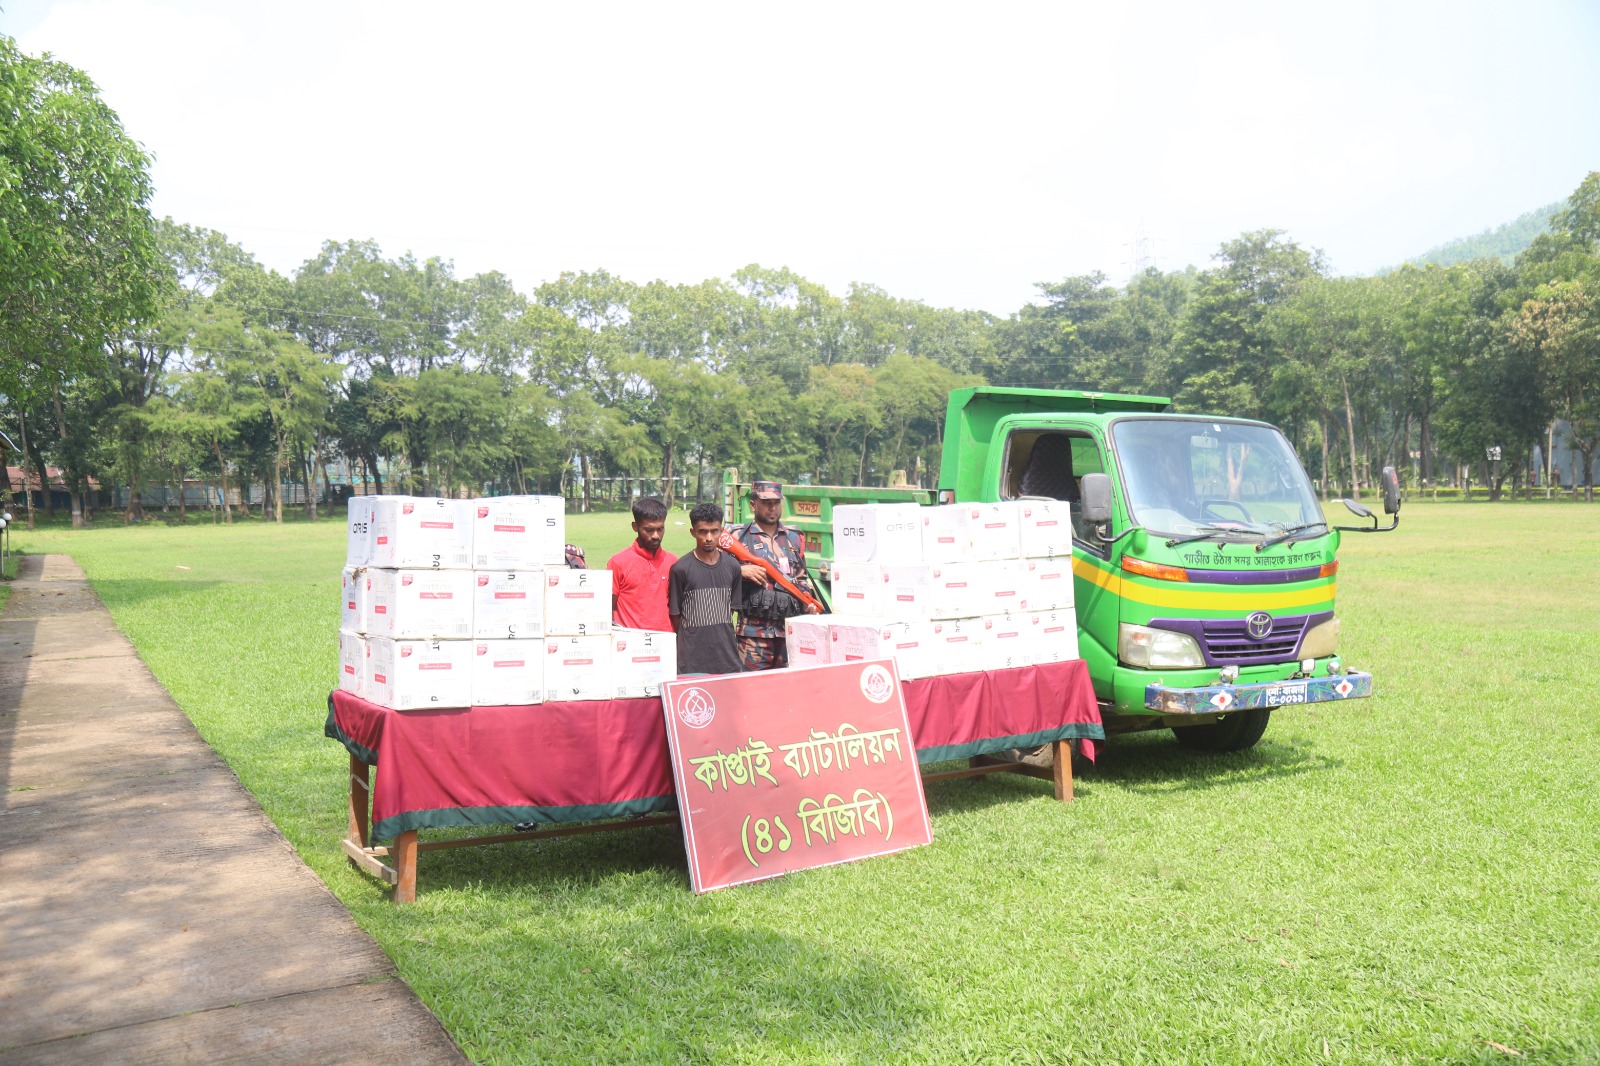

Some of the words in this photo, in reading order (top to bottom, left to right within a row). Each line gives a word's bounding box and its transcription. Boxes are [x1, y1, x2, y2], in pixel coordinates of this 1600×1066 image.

[352, 522, 368, 534] ORIS
[843, 527, 865, 537] ORIS
[886, 522, 915, 532] ORIS
[688, 737, 779, 793] কাপ্তাই
[778, 722, 903, 779] ব্যাটালিয়ন
[740, 814, 792, 868] (৪১
[796, 788, 895, 847] বিজিবি)
